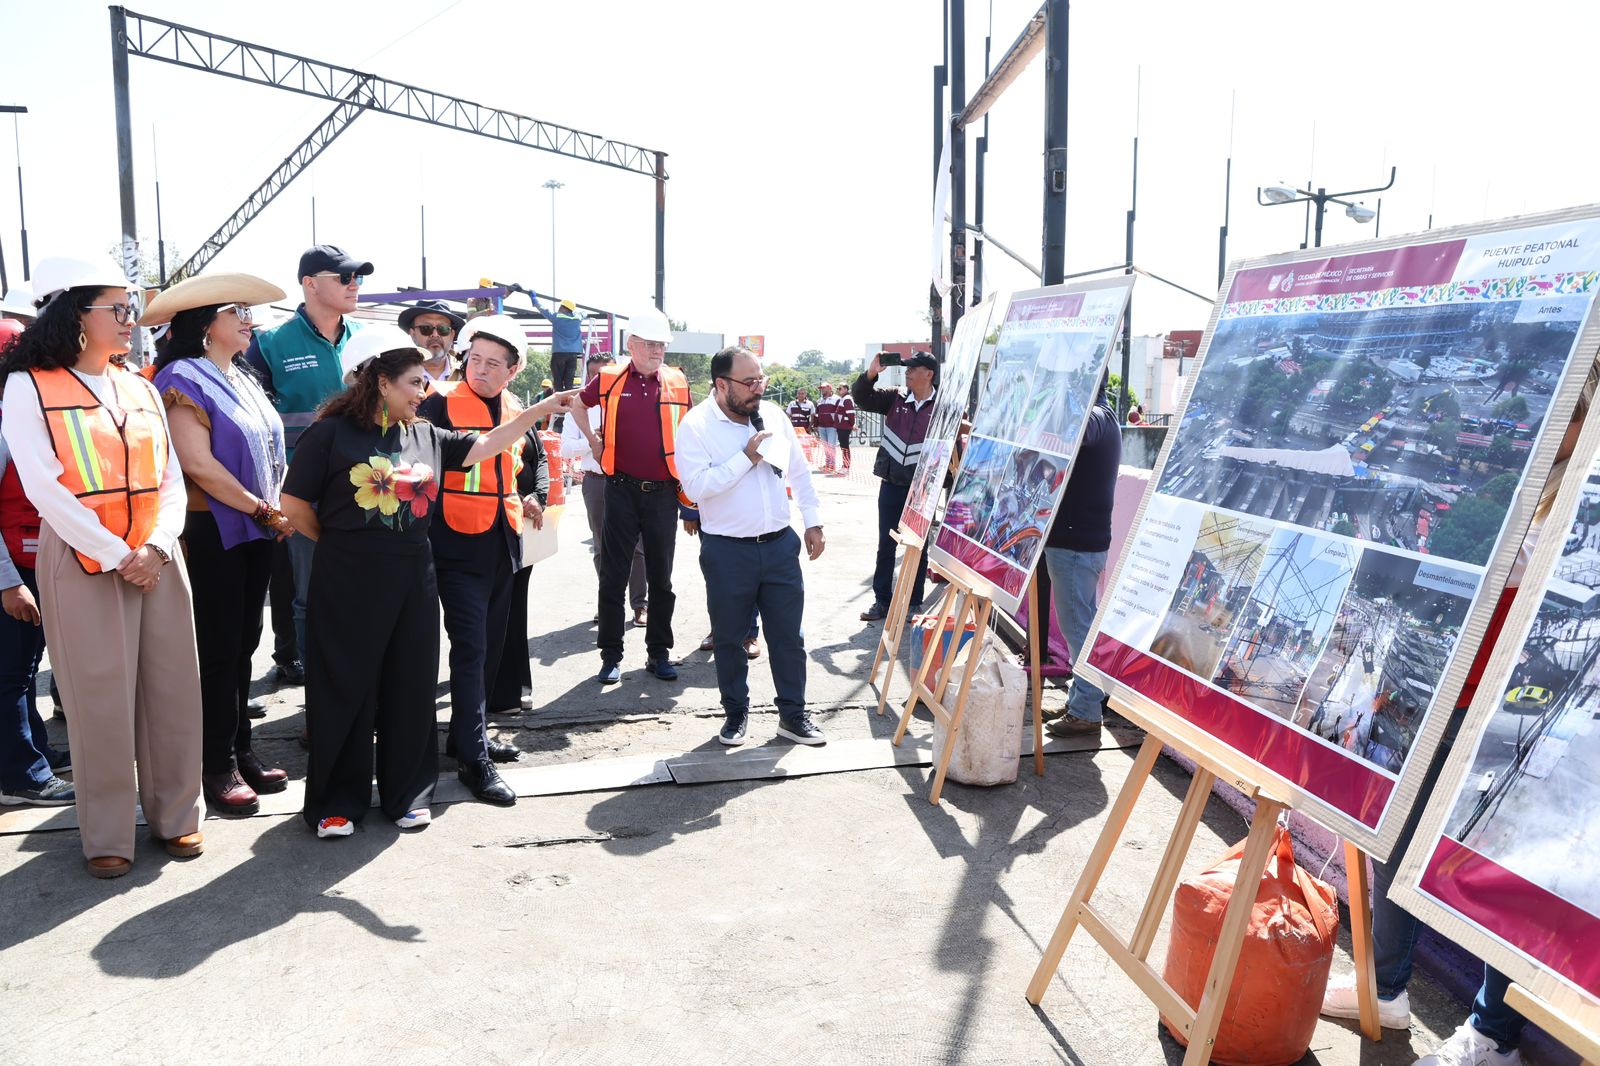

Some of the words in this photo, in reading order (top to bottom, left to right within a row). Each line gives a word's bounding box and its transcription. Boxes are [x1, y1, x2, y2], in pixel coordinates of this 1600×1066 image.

[1483, 245, 1521, 257] PUENTE
[1523, 238, 1579, 253] PEATONAL
[1497, 255, 1551, 268] HUIPULCO
[1538, 306, 1562, 314] Antes
[1324, 546, 1347, 559] Limpieza
[1417, 569, 1476, 590] Desmantelamiento
